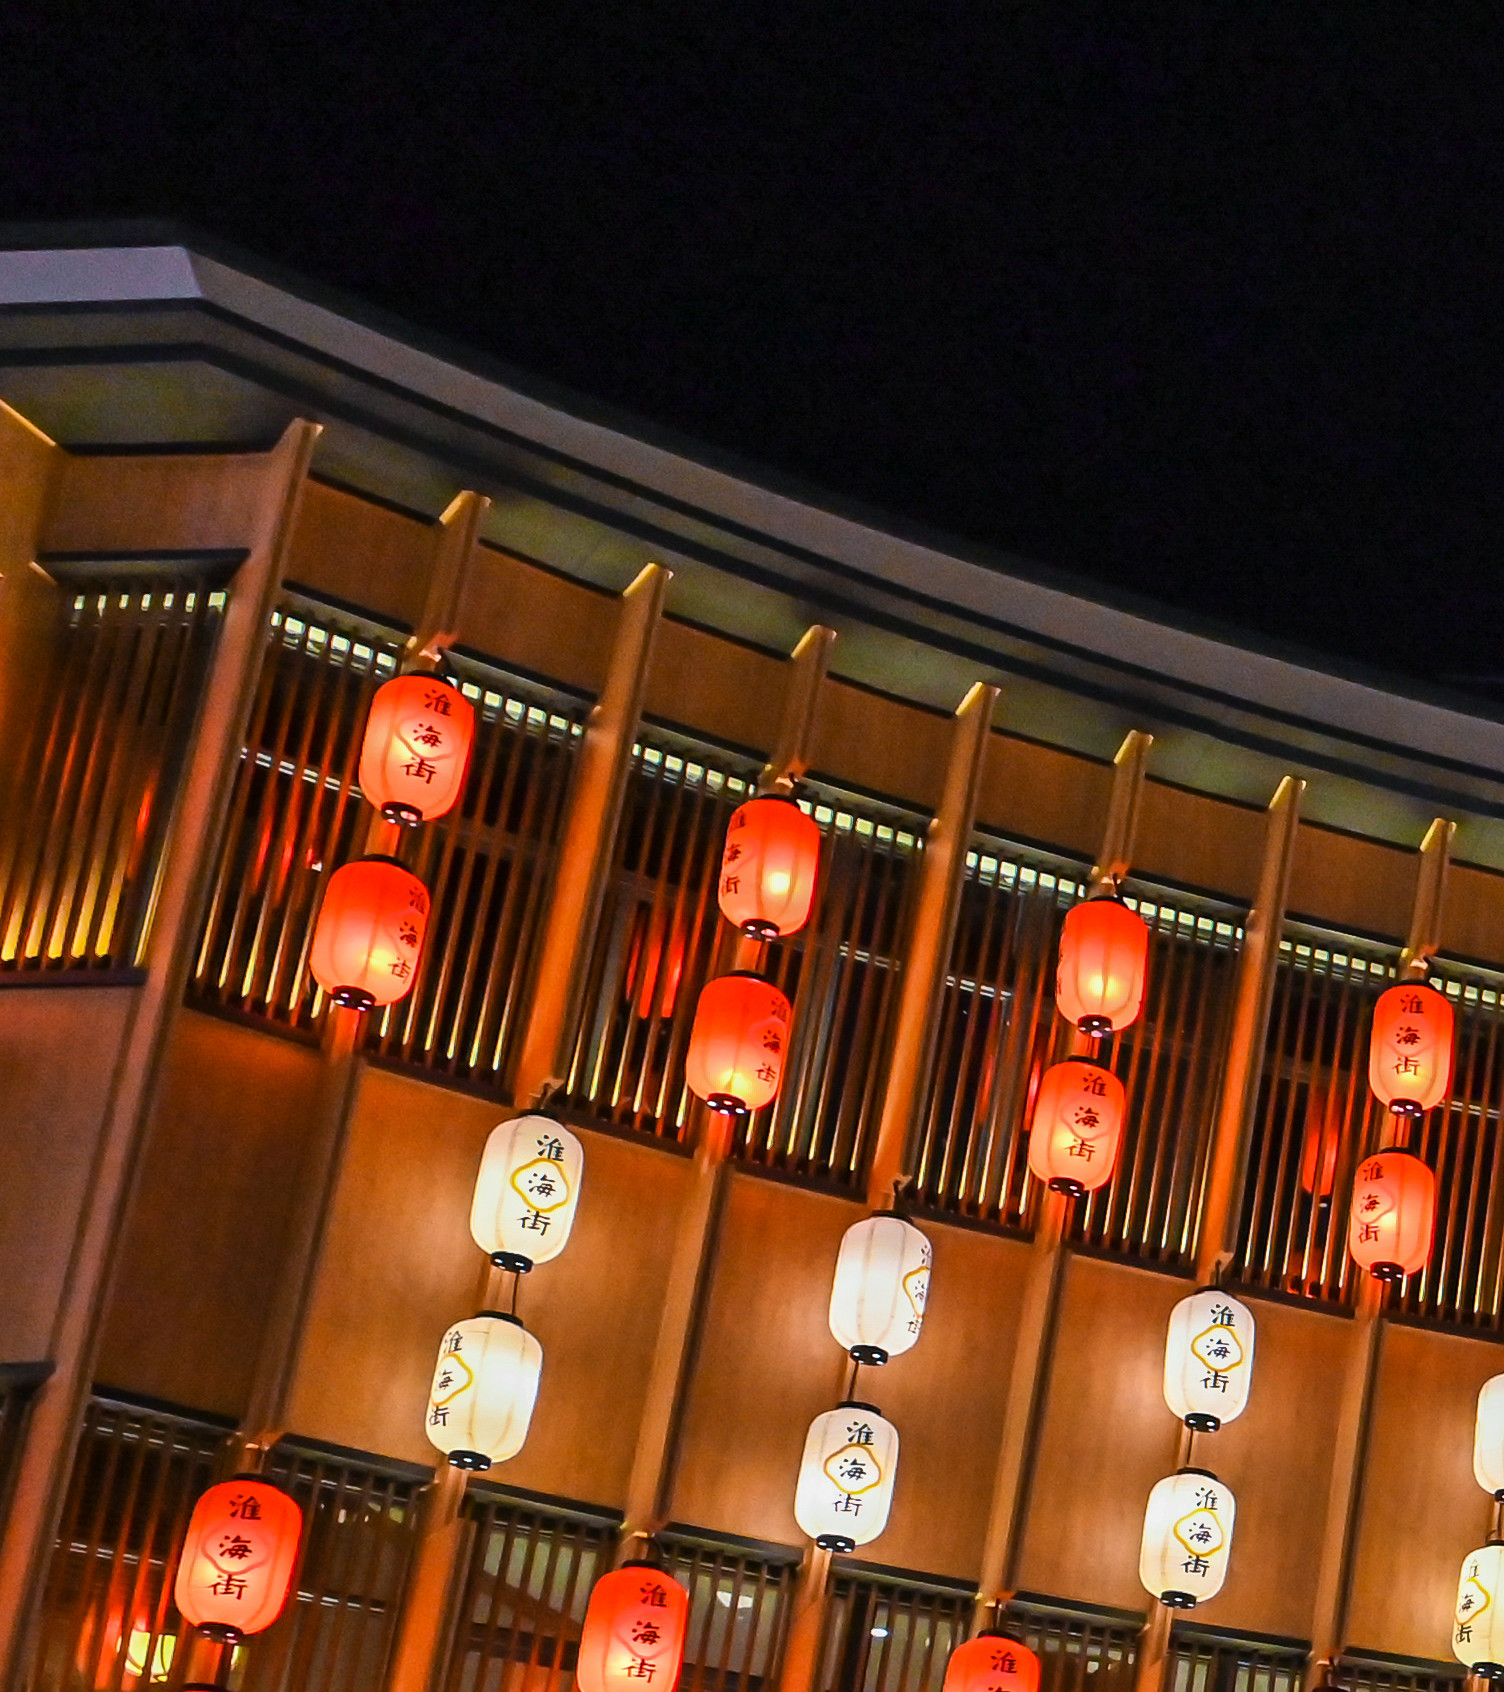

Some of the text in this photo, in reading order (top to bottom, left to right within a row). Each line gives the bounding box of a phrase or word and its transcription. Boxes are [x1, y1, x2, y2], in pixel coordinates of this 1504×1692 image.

[401, 689, 453, 785] 淮海街
[1391, 995, 1424, 1076] 淮海街
[1066, 1073, 1108, 1162] 淮海街
[516, 1134, 566, 1238] 淮海街
[1358, 1161, 1387, 1242] 淮海街
[1200, 1304, 1236, 1394] 淮海街
[831, 1423, 875, 1518] 淮海街
[208, 1494, 262, 1600] 淮海街
[1181, 1486, 1220, 1576] 淮海街
[621, 1582, 668, 1684] 淮海街
